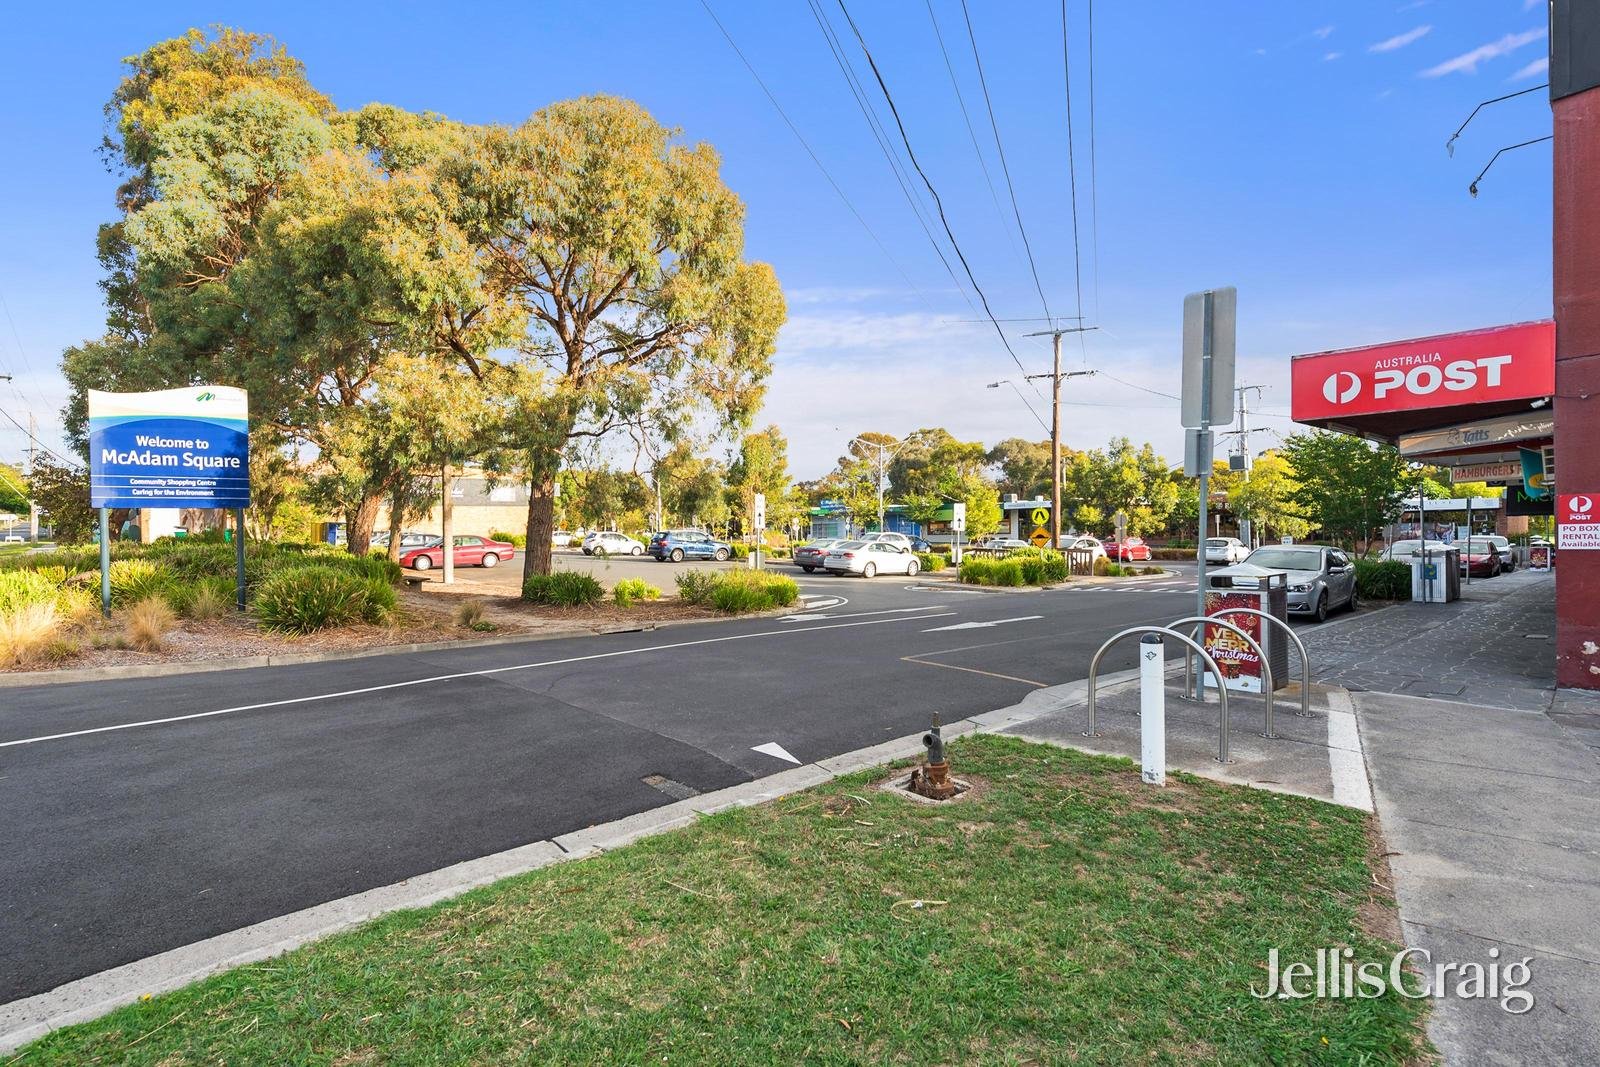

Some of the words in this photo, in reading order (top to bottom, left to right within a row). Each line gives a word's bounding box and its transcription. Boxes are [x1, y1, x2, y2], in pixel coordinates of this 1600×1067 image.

[1375, 353, 1441, 369] AUSTRALIA
[1375, 355, 1512, 399] POST
[136, 435, 193, 448] Welcome
[195, 439, 209, 449] to
[1463, 430, 1489, 442] Tatts
[102, 449, 178, 466] McAdam
[183, 453, 240, 470] Square
[1454, 465, 1514, 478] HAMBURGERS
